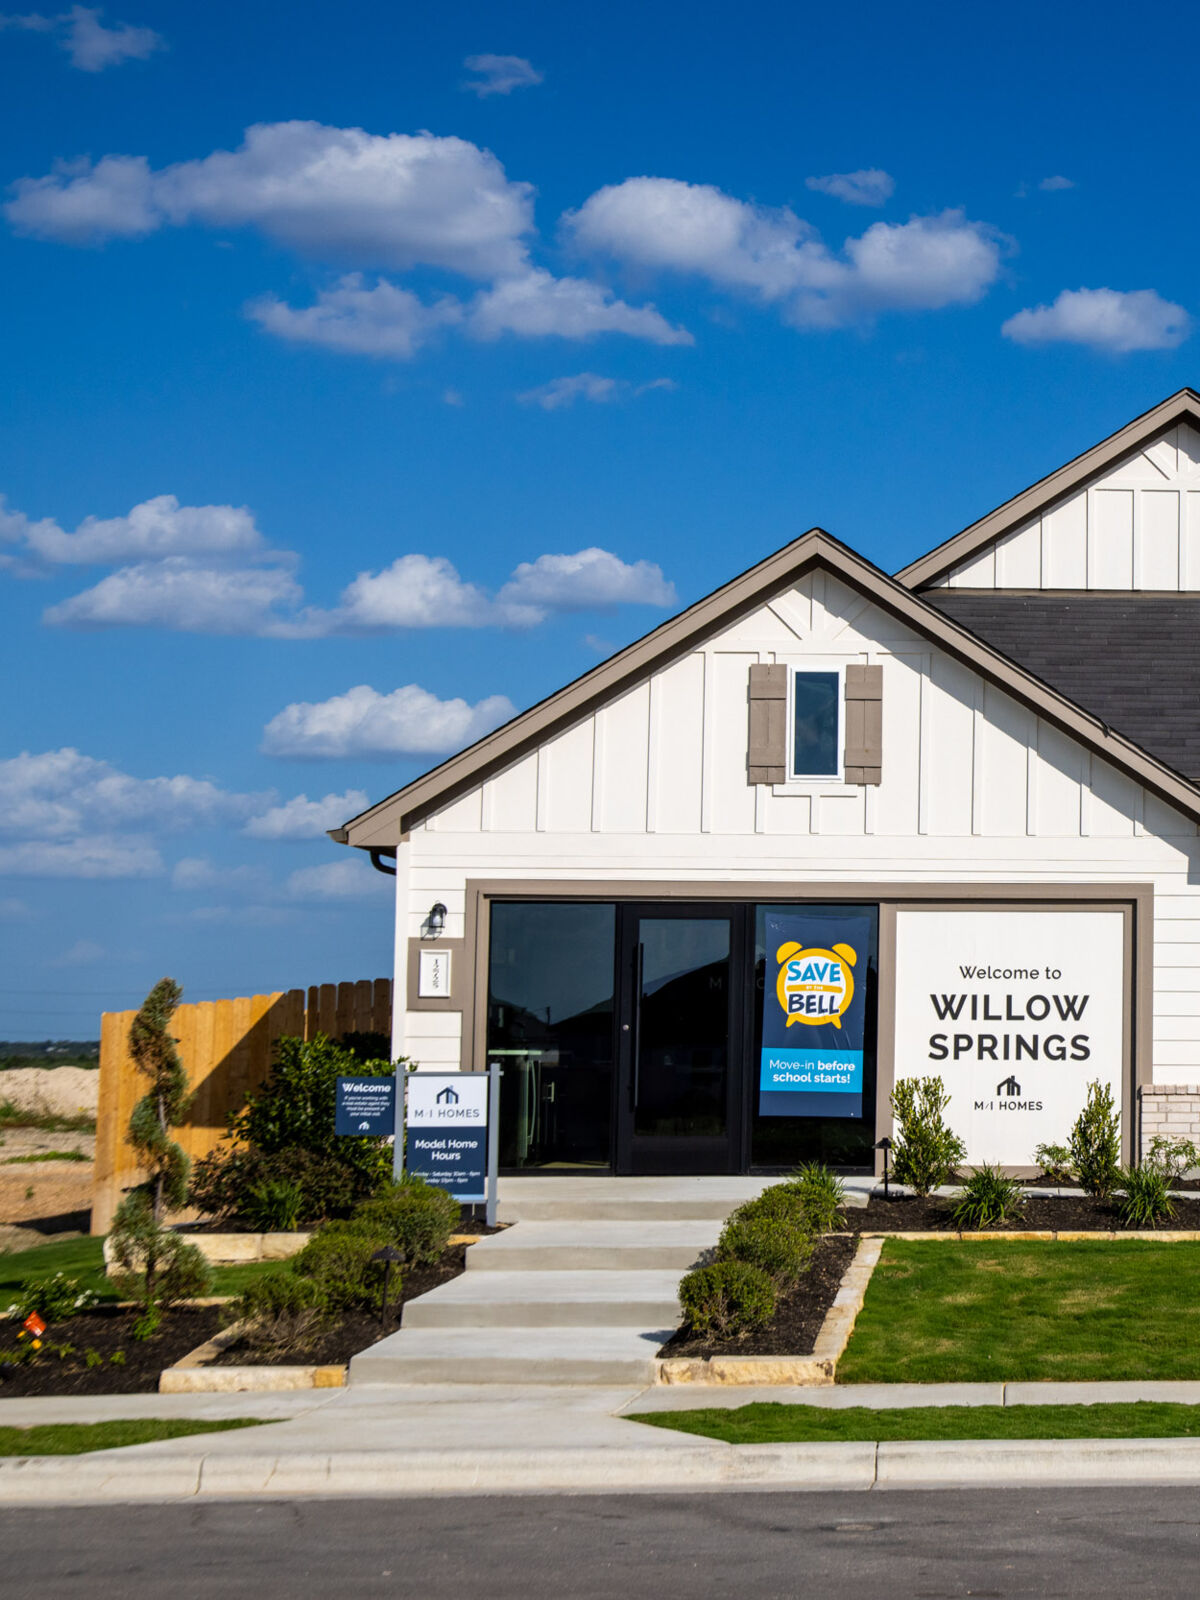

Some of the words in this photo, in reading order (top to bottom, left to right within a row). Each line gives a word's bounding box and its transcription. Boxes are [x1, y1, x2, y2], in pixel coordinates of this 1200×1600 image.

[787, 961, 840, 983] SAVE
[959, 965, 1040, 980] Welcome
[1045, 967, 1062, 980] to
[788, 993, 839, 1015] BELL
[930, 994, 1090, 1021] WILLOW
[928, 1033, 1091, 1061] SPRINGS
[769, 1059, 815, 1071] Move-in
[817, 1060, 856, 1072] before
[773, 1071, 812, 1083] school
[814, 1072, 851, 1084] starts!
[342, 1083, 391, 1093] Welcome
[999, 1101, 1043, 1111] HOMES
[438, 1109, 480, 1118] HOMES
[415, 1139, 446, 1149] Model
[448, 1139, 478, 1149] Home
[431, 1151, 461, 1161] Hours
